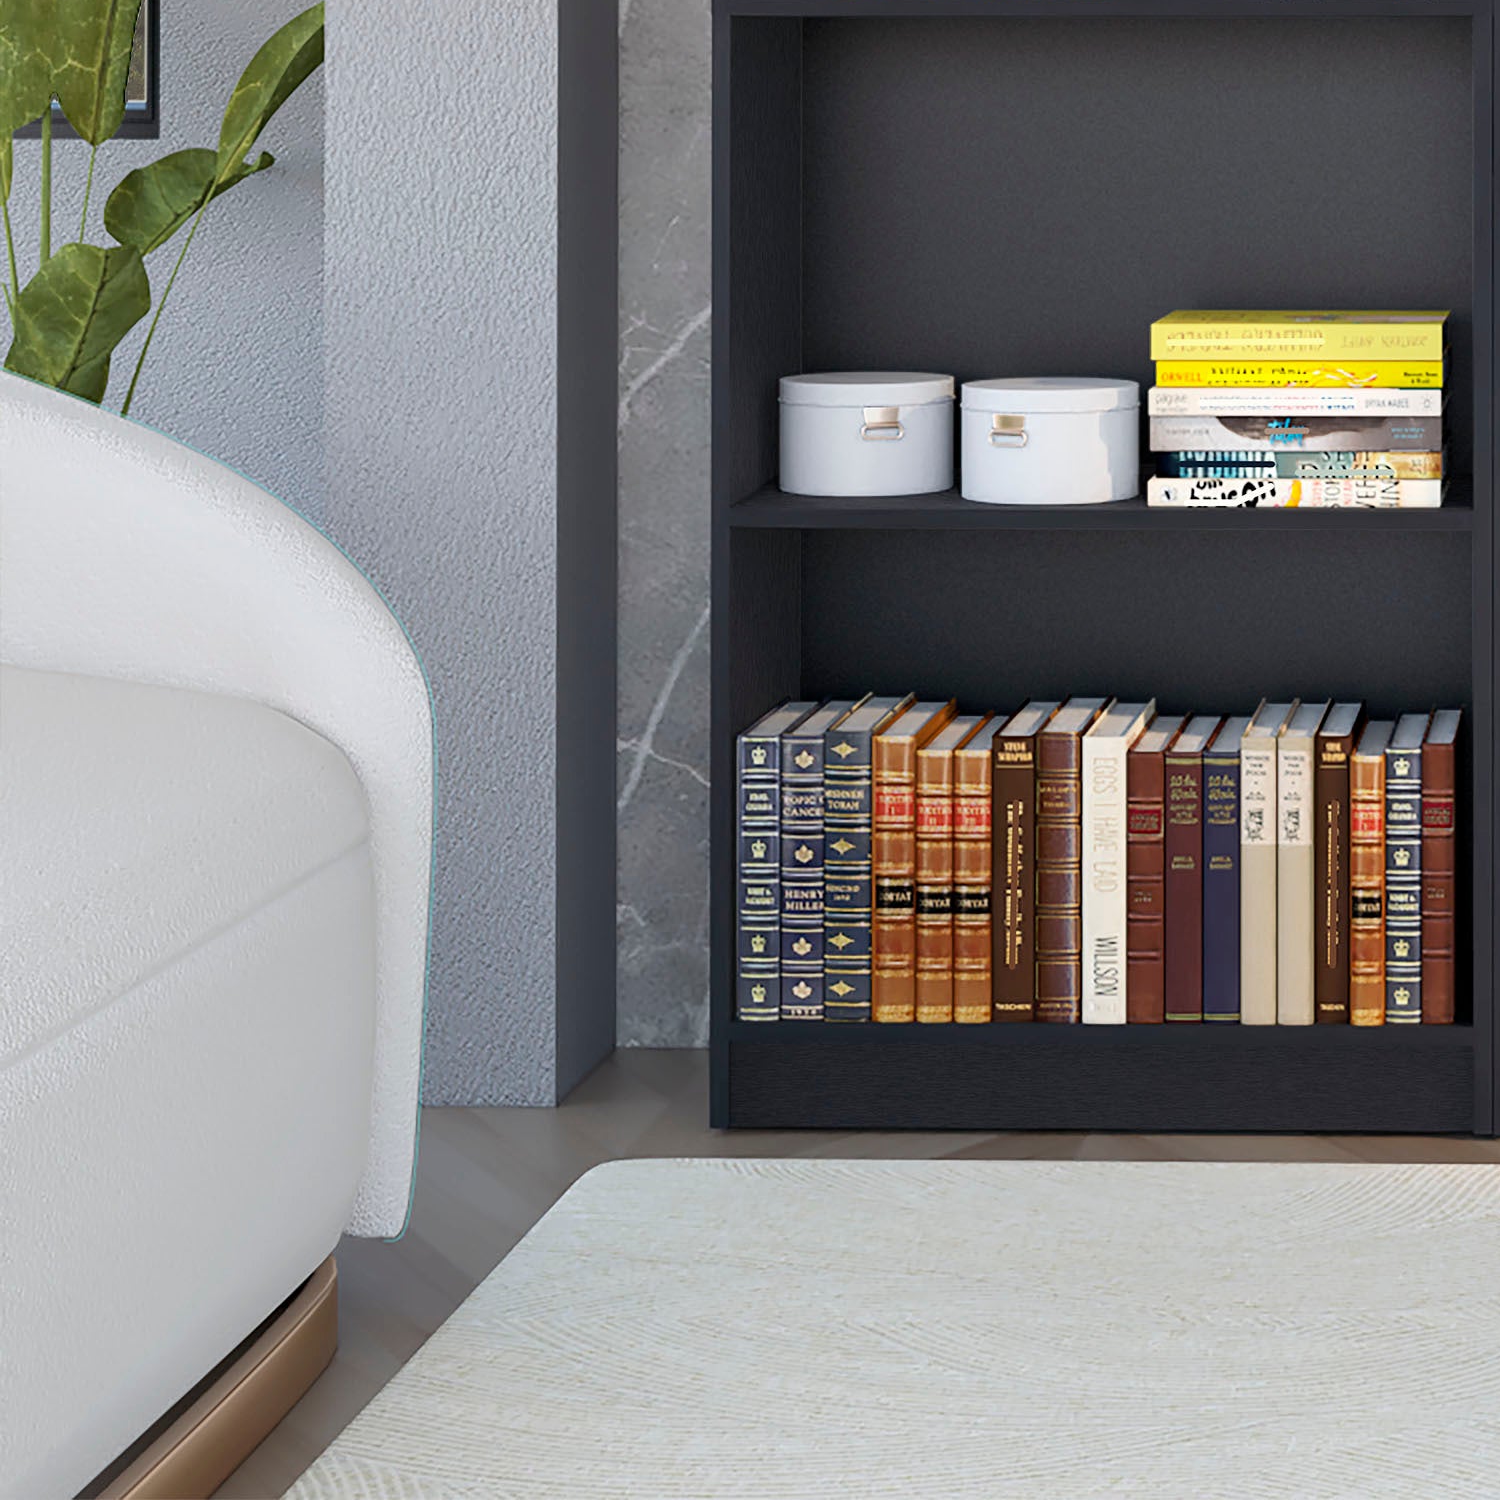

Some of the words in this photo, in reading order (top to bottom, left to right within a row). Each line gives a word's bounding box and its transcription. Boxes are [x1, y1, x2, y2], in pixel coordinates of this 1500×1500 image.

[1160, 371, 1203, 382] ORWELL
[1093, 757, 1119, 796] EGGS
[783, 807, 824, 817] CANCE
[1093, 813, 1119, 854] HAVE
[784, 889, 824, 899] HENRY
[1093, 860, 1119, 894] LAID
[1094, 935, 1119, 997] WILLSON
